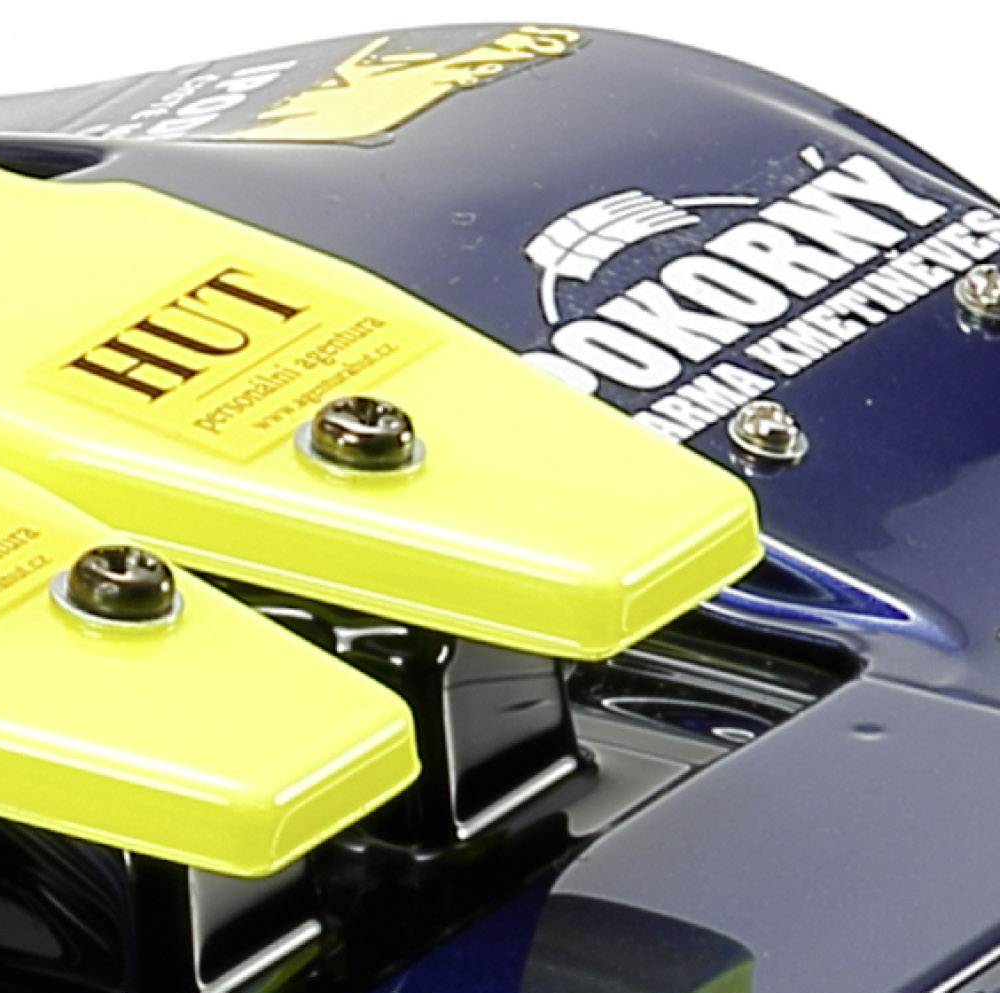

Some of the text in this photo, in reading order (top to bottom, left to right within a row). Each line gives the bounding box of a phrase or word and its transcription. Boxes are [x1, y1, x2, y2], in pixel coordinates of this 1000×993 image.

[59, 267, 311, 403] HUT
[296, 316, 387, 371] agentura
[633, 362, 776, 442] ARMA
